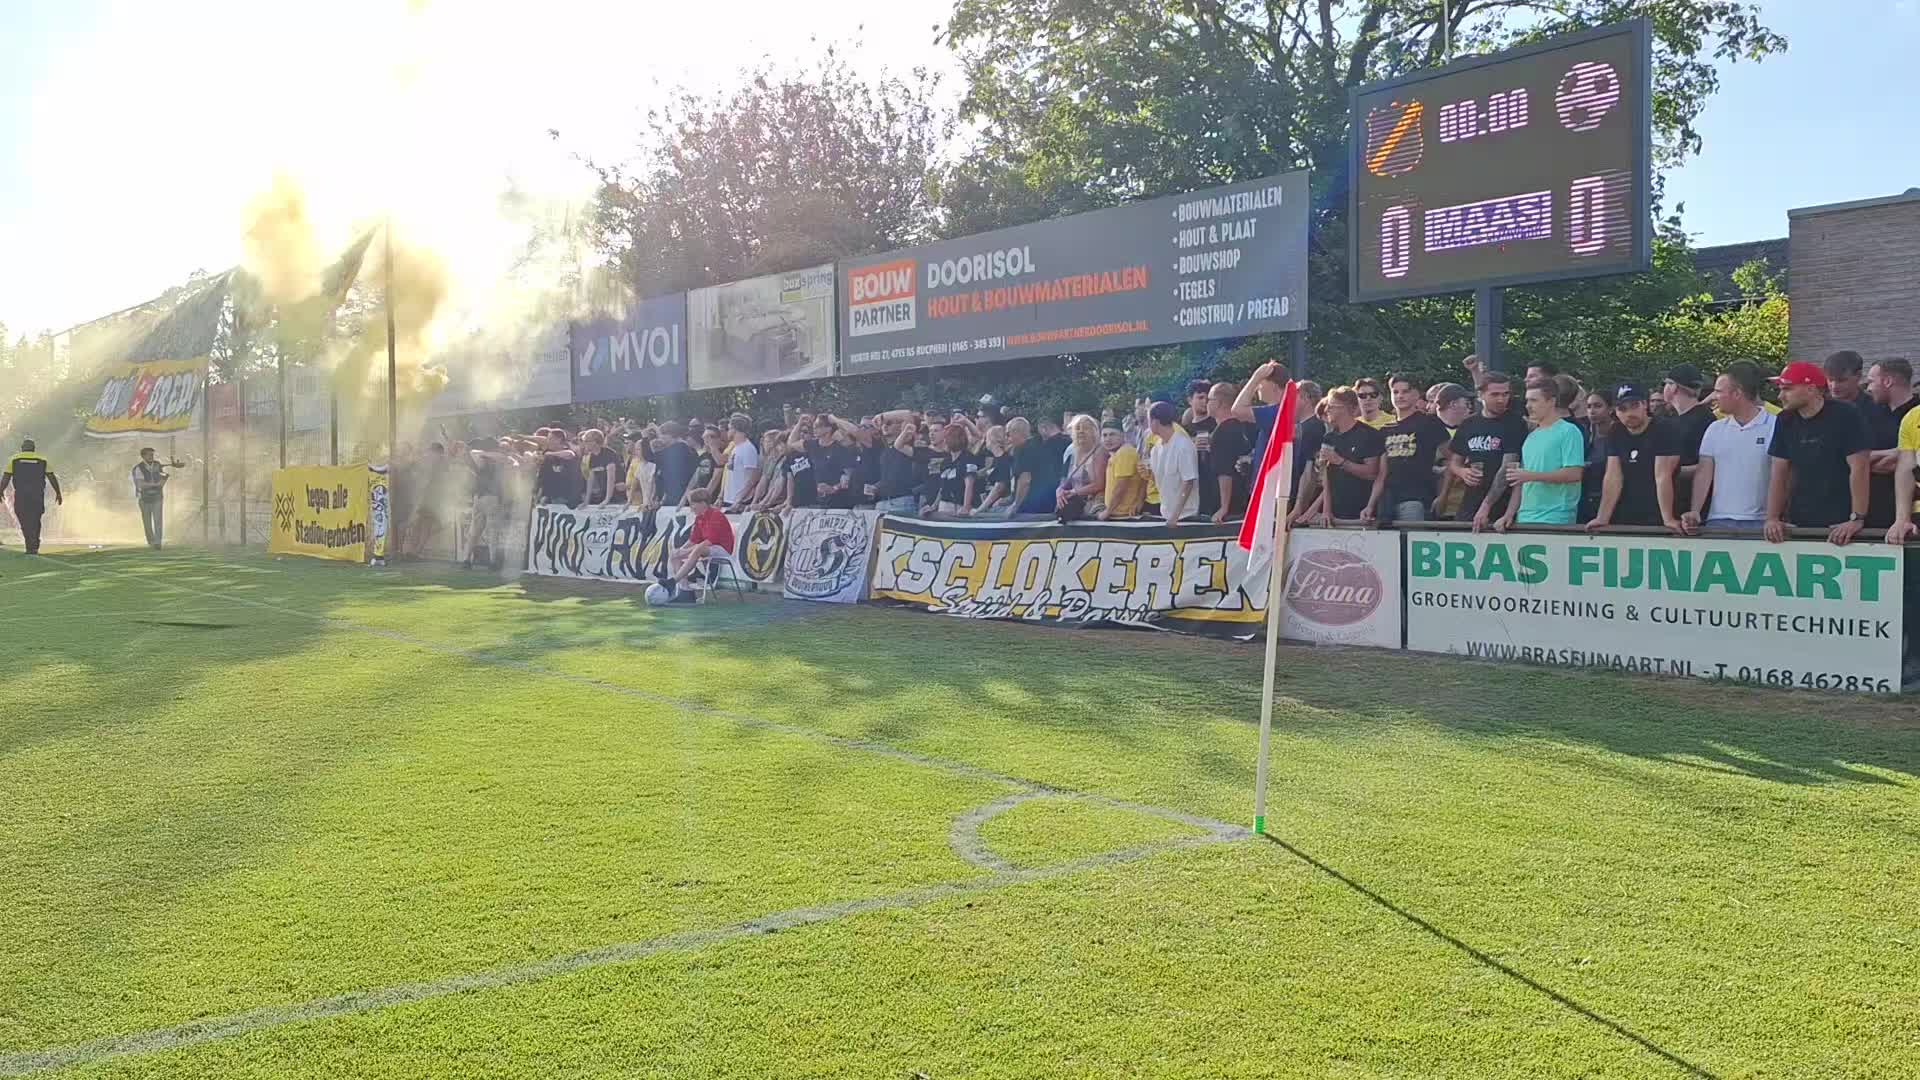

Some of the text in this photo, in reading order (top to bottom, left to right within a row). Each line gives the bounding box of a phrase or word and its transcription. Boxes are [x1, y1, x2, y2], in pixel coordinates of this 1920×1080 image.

[1439, 88, 1528, 143] 00:00
[1178, 186, 1283, 222] BOUWMATERIALEN
[1179, 218, 1257, 249] HOUT & PLAAT
[1381, 205, 1410, 278] 0
[1569, 176, 1605, 254] 0
[927, 246, 1036, 289] DOORISOL
[1179, 248, 1241, 274] BOUWSHOP
[853, 267, 912, 301] BOUW
[927, 295, 969, 319] HOUT
[984, 265, 1149, 313] BOUWMATERIALEN
[1179, 279, 1216, 300] TEGELS
[854, 303, 911, 328] PARTNER
[1237, 303, 1245, 321] /
[1247, 296, 1289, 320] PREFAB
[952, 341, 969, 353] 0165
[874, 533, 1272, 611] KSC LOKEREN
[1287, 569, 1375, 605] Liana
[1411, 540, 1897, 602] BRAS FIJNAART
[1412, 591, 1891, 639] GROENVOORZIENING & CULTUURTECHNIEK
[1738, 666, 1794, 687] 0168
[1799, 671, 1892, 694] 462856
